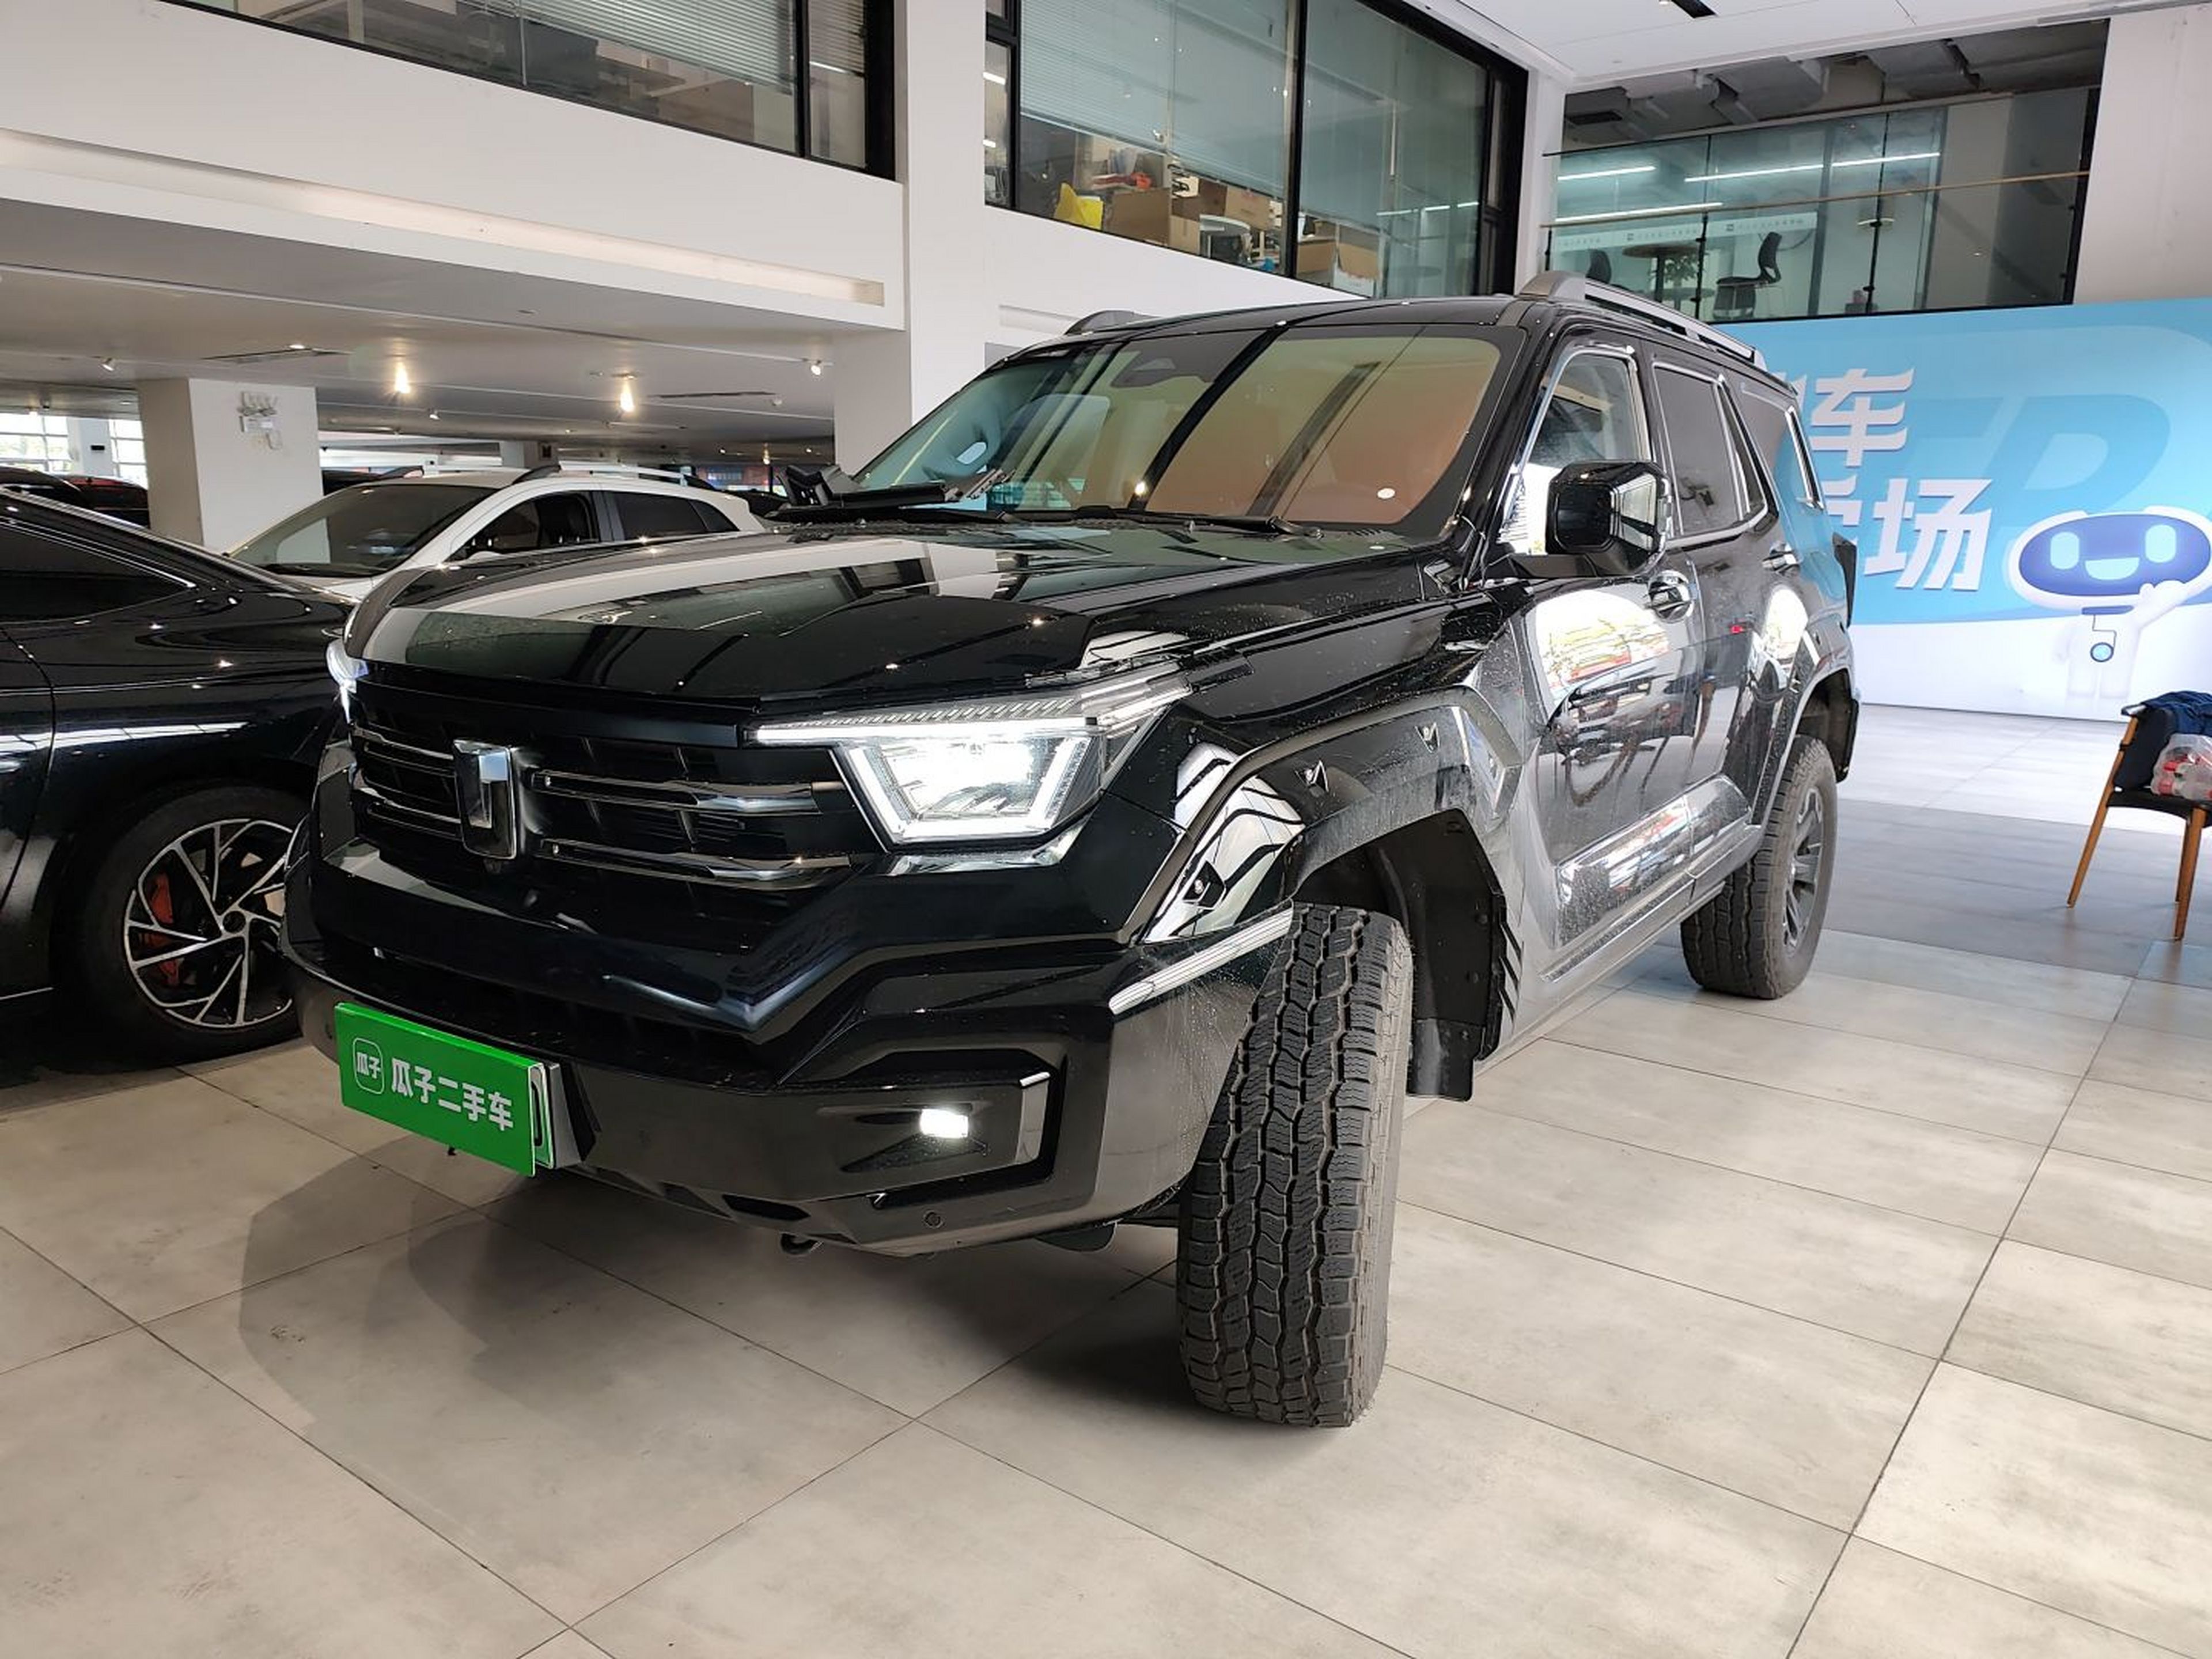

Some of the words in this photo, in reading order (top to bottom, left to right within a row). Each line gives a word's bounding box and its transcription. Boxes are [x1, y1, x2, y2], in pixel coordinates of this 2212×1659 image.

[1776, 368, 1915, 468] 车
[357, 1052, 381, 1079] 瓜子
[391, 1058, 513, 1131] 瓜子二手车
